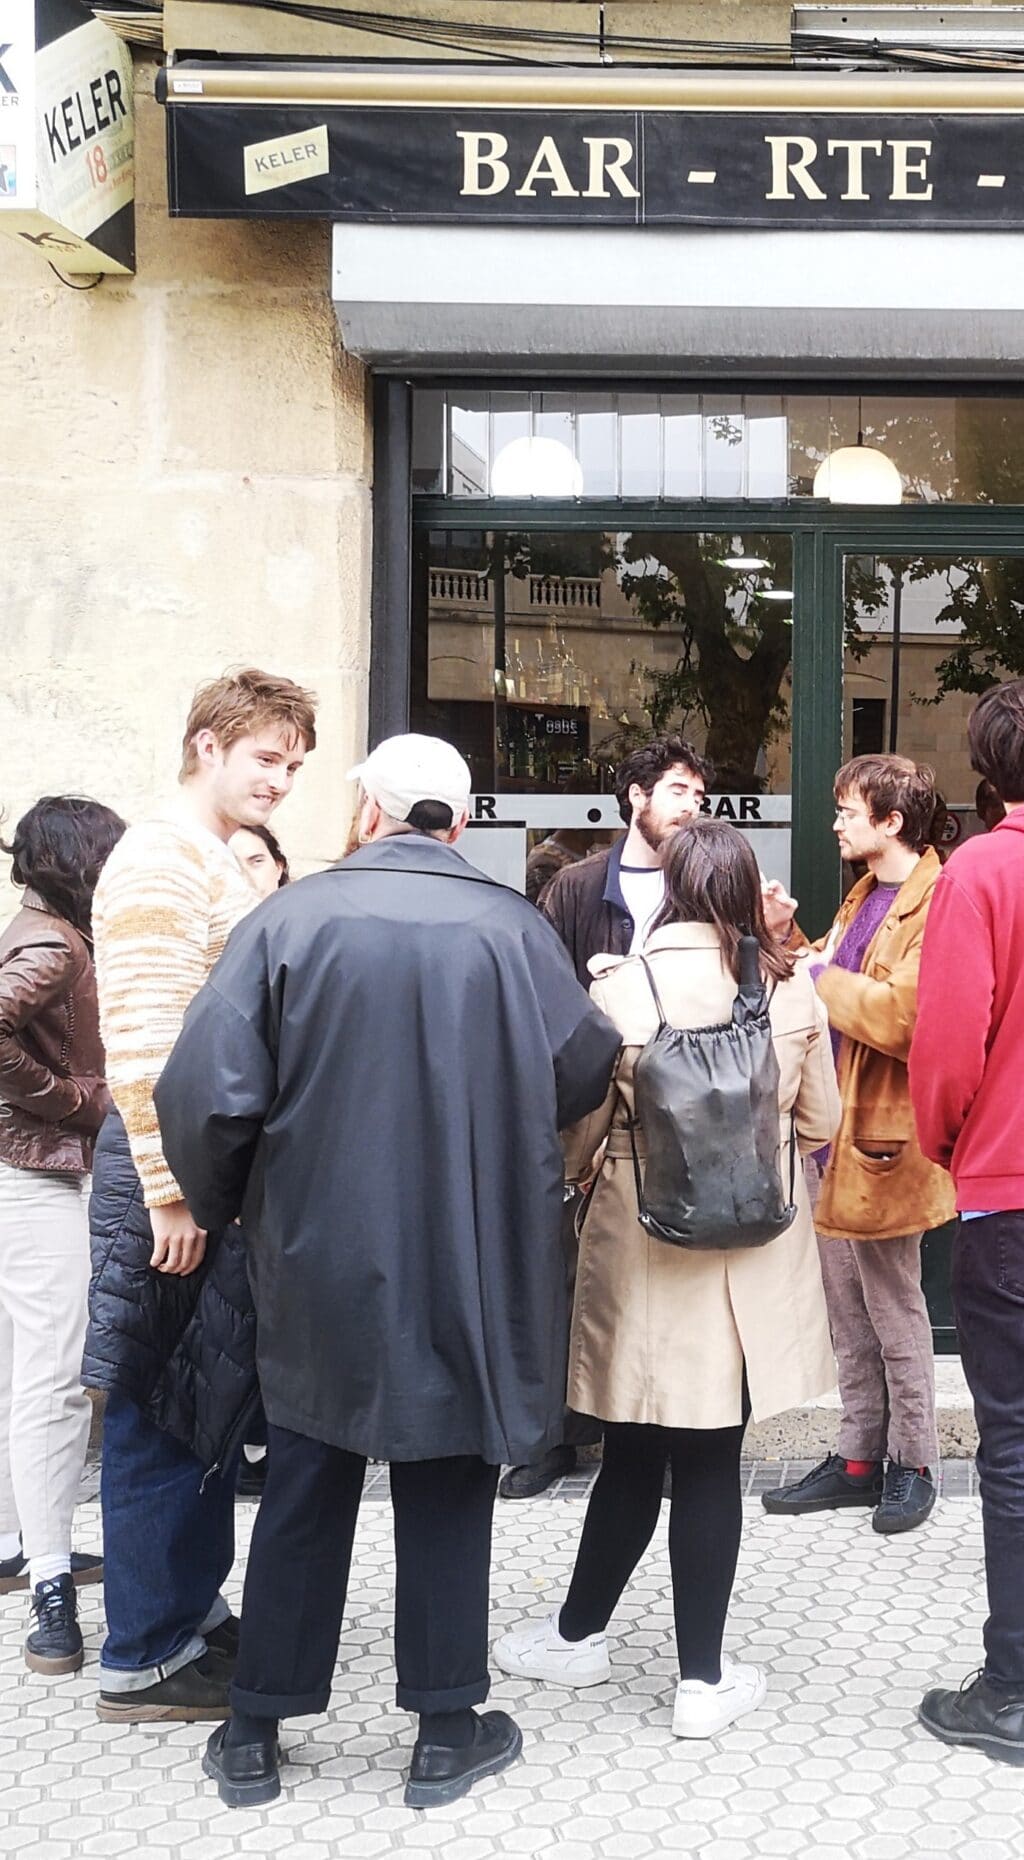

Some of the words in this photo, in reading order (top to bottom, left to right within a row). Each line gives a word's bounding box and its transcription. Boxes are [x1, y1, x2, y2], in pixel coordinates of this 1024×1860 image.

[44, 68, 127, 164] KELER
[85, 144, 108, 189] 18
[254, 143, 319, 172] KELER
[456, 131, 641, 200] BAR
[764, 136, 934, 201] RTE
